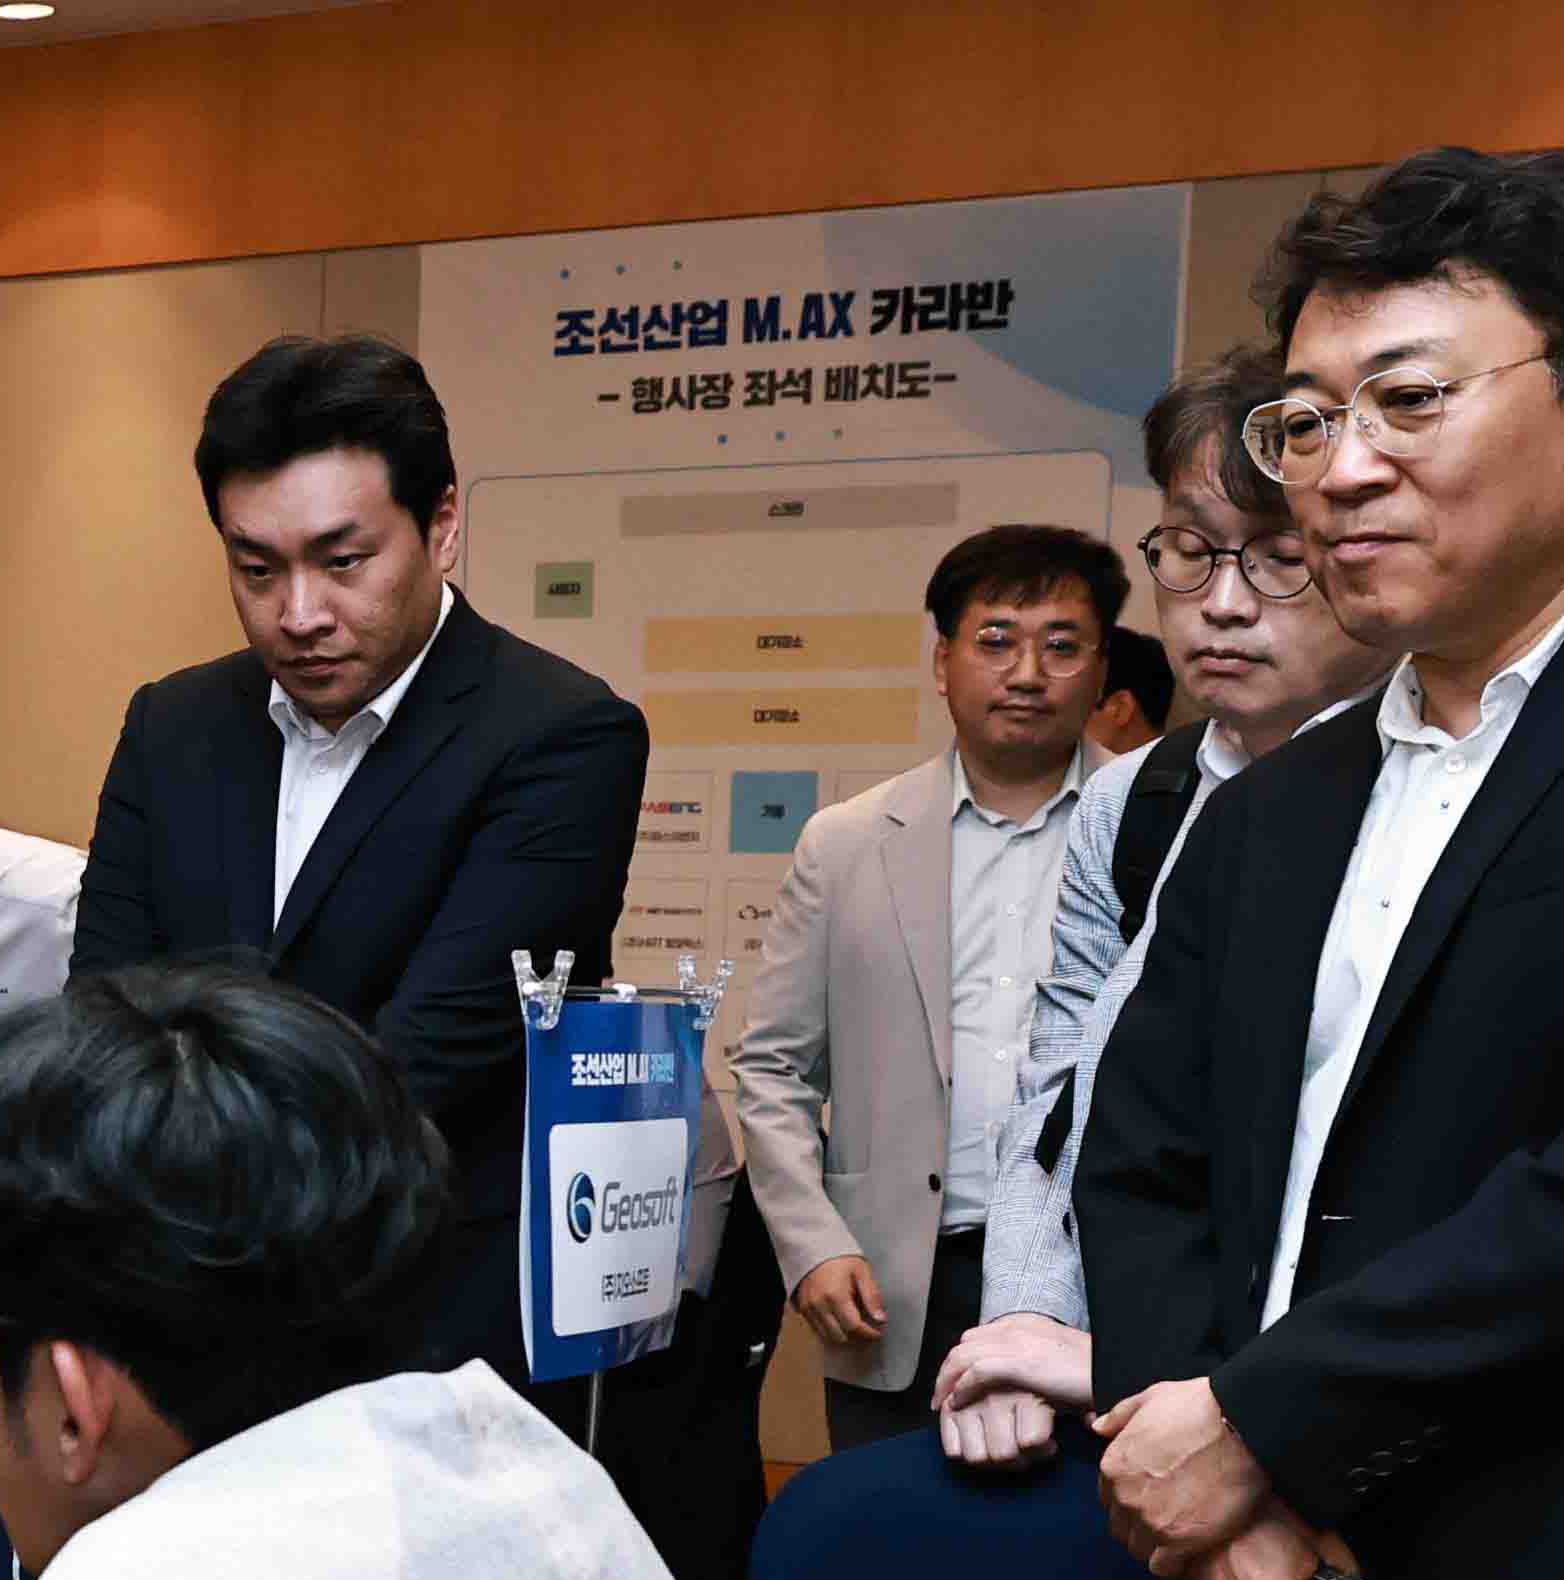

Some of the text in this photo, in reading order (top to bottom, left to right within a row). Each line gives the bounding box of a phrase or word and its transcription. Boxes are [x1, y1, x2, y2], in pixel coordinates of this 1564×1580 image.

[554, 278, 1015, 357] 조선산업 M.AX 카라반
[632, 372, 733, 415] 행사장
[743, 367, 813, 409] 좌석
[571, 1053, 625, 1086] 조선산업
[600, 1175, 678, 1233] Geosoft
